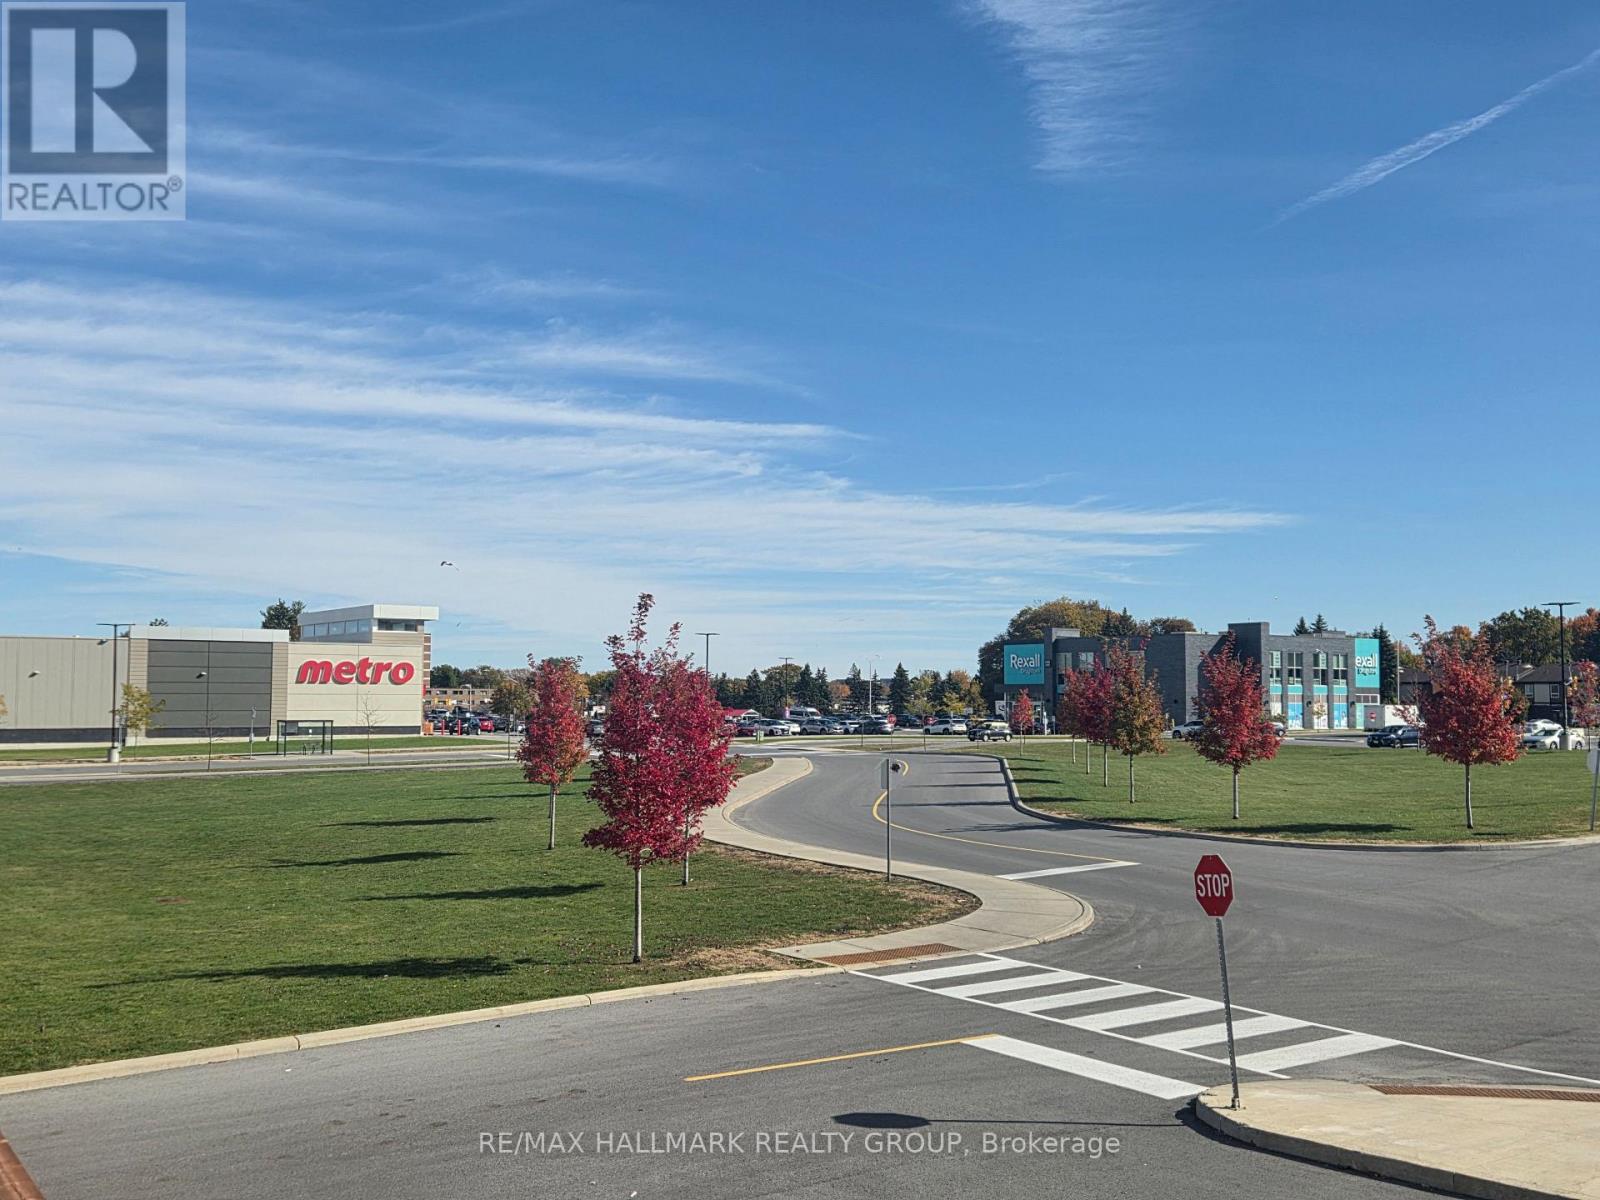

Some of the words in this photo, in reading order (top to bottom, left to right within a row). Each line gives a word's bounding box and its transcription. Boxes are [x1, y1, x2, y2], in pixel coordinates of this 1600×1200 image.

[1010, 653, 1040, 669] Rexall
[1355, 653, 1378, 668] exall
[295, 657, 414, 685] metro
[1197, 873, 1230, 897] STOP
